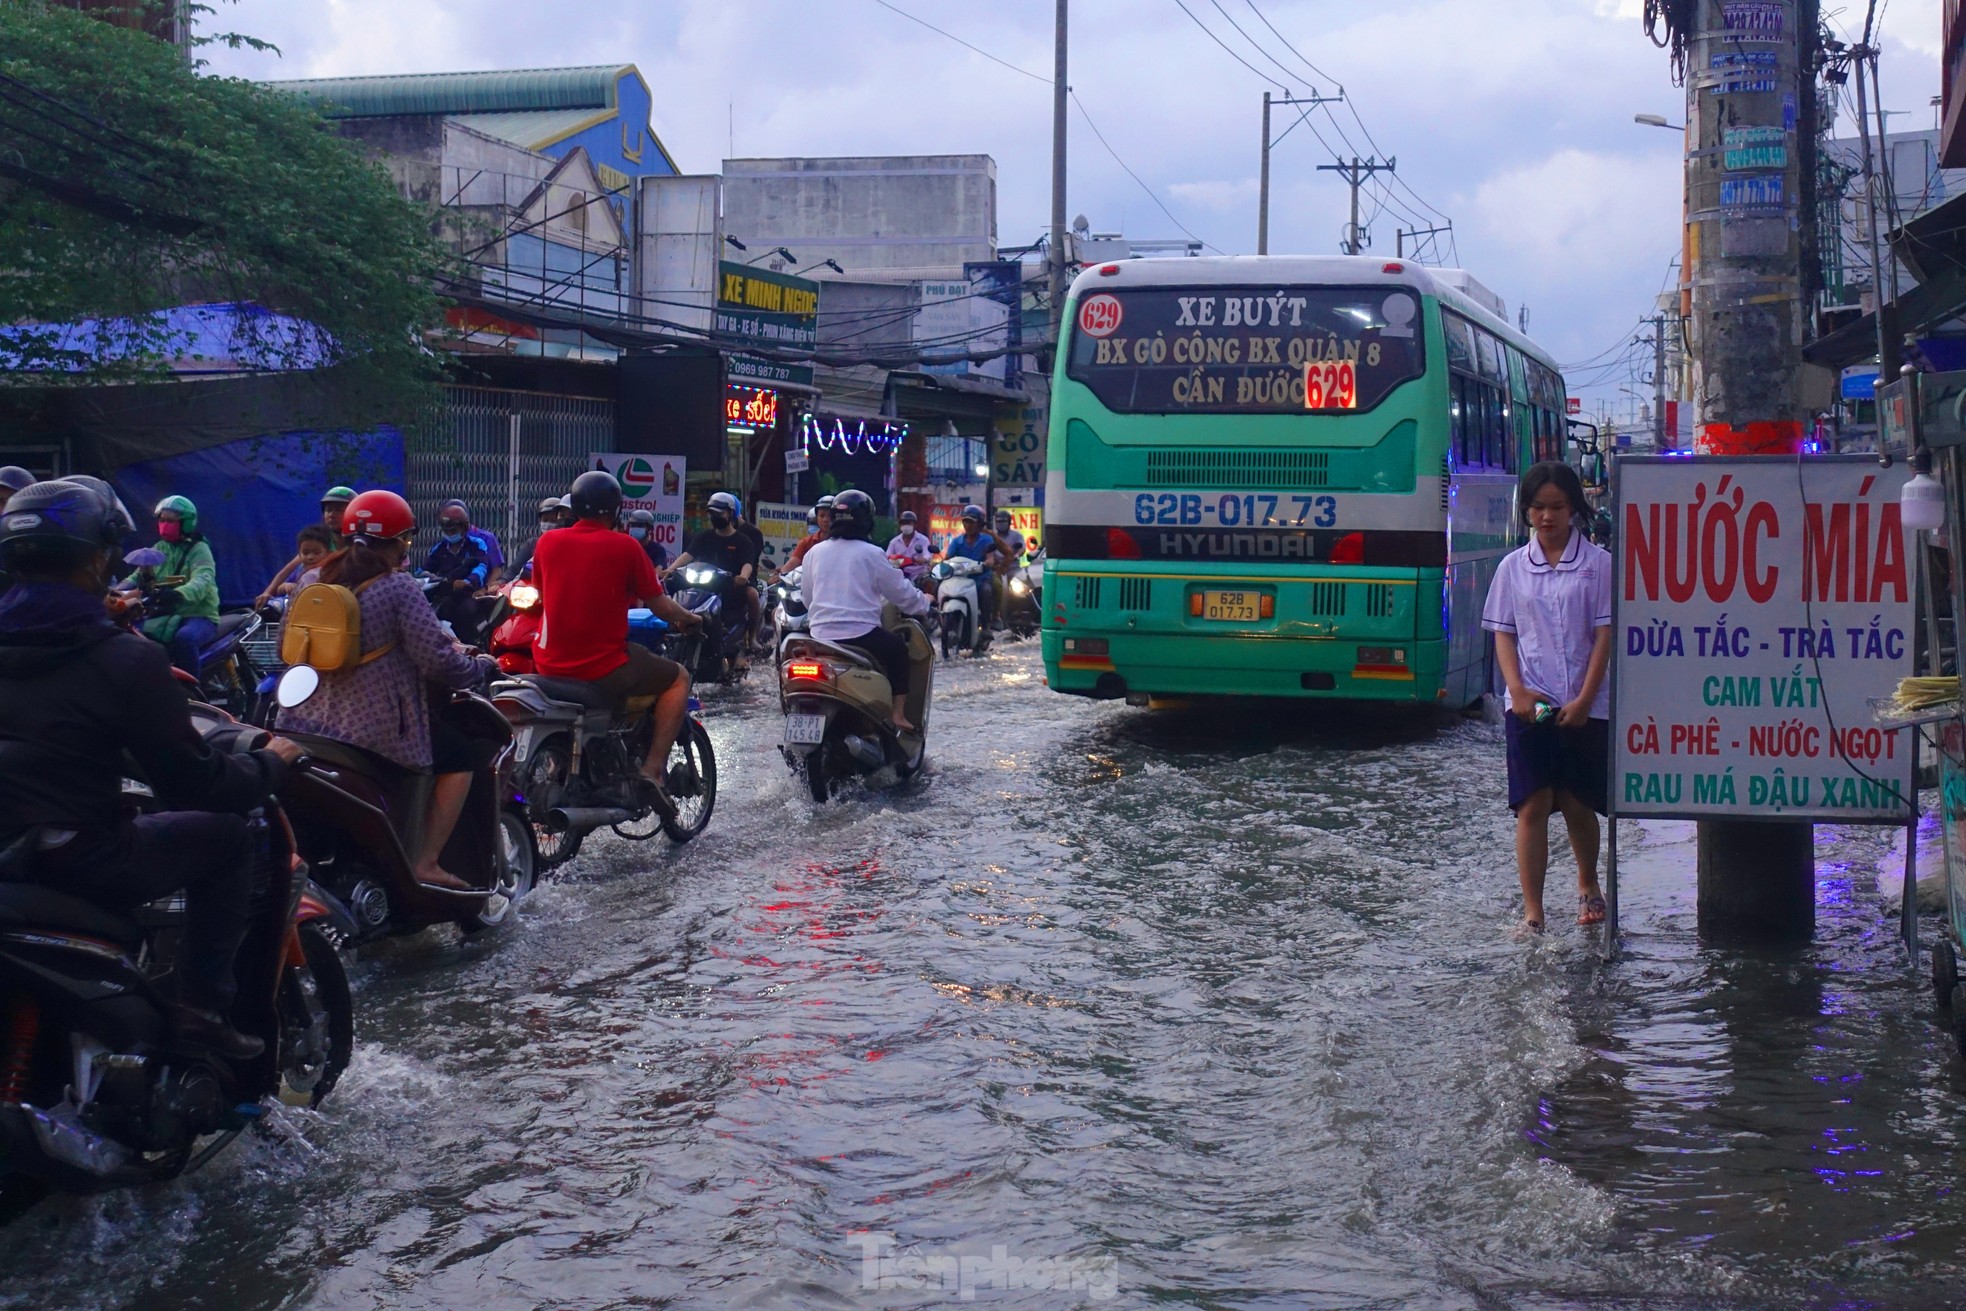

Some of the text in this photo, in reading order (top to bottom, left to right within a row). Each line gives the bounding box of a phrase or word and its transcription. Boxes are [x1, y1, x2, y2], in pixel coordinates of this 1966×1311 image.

[724, 274, 817, 322] XE MINH NGỌC
[1083, 301, 1119, 330] 629
[1175, 290, 1307, 327] XE BUÝT
[729, 317, 737, 332] GA
[741, 319, 749, 334] XE
[751, 317, 759, 336] SỐ
[1096, 338, 1127, 364] BX
[1133, 330, 1167, 363] GÒ
[1173, 330, 1240, 364] CÔNG
[1248, 337, 1281, 363] BX
[1366, 342, 1381, 366] 8
[735, 362, 790, 380] 0969 987 787
[1173, 366, 1305, 404] CẦN ĐƯỚC
[1307, 364, 1354, 409] 629
[999, 424, 1039, 453] GỖ
[996, 456, 1043, 483] SẤY
[621, 499, 657, 510] astrol
[1134, 493, 1337, 527] 62B-017.73
[1624, 474, 1908, 604] NƯỚC MÍA
[1210, 606, 1253, 619] 017.73
[1220, 593, 1244, 605] 62B
[1627, 617, 1684, 657] DỪA
[1693, 613, 1750, 657] TẮC
[1778, 620, 1835, 659] TRÀ
[1846, 614, 1904, 659] TẮC
[1703, 664, 1820, 708] CAM VẮT
[1627, 716, 1660, 755] CÀ
[1670, 717, 1720, 756] PHÊ
[1749, 718, 1819, 758] NƯỚC
[1829, 727, 1899, 765] NGỌT
[1624, 766, 1900, 812] RAU MÁ ĐẬU XANH
